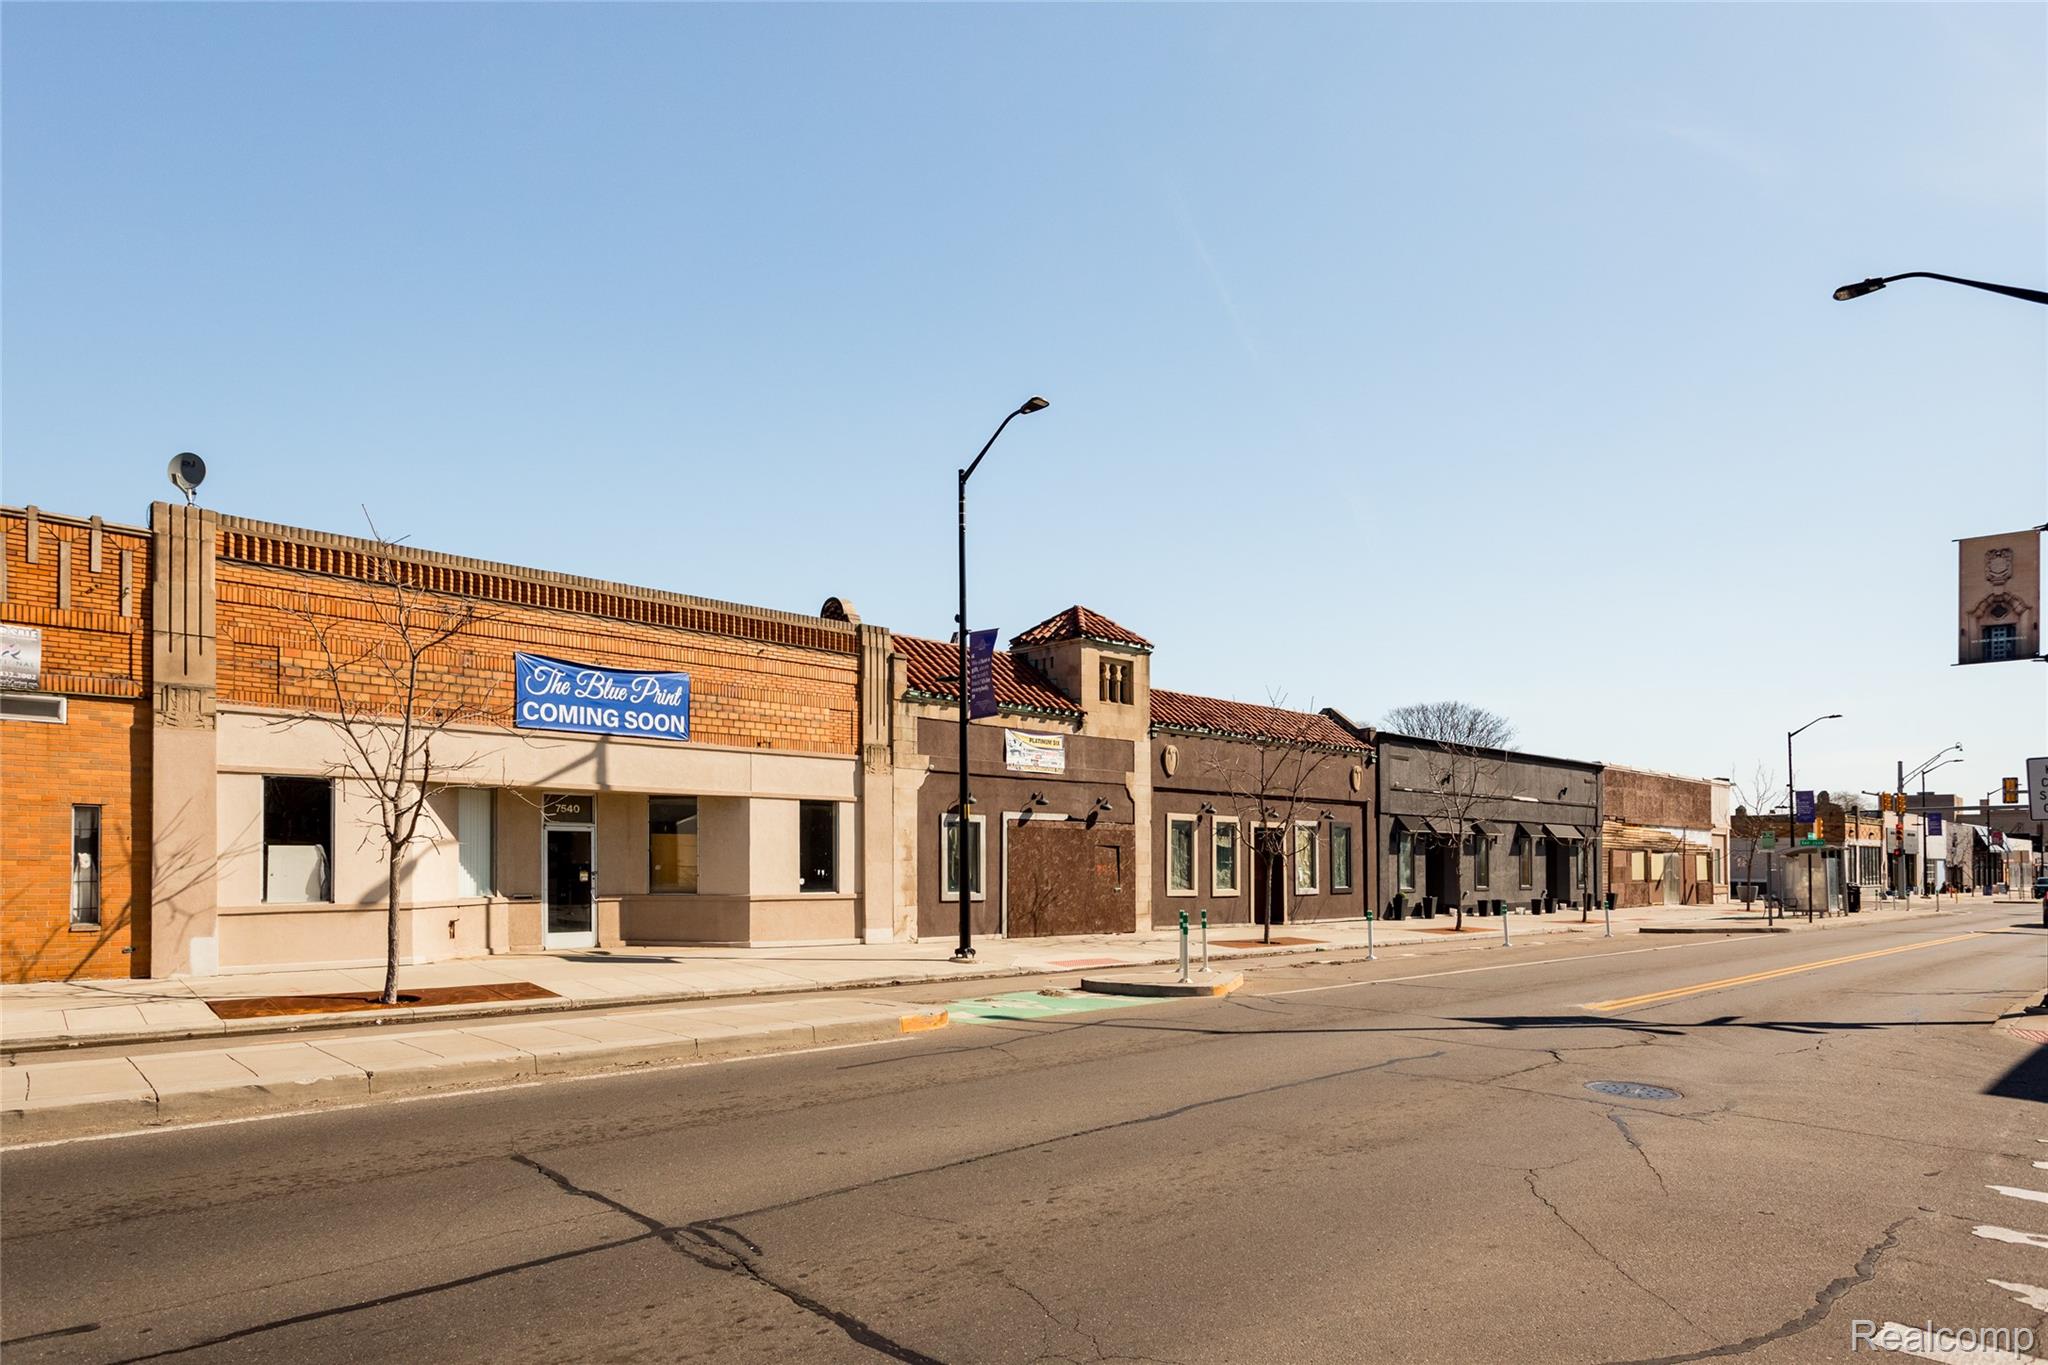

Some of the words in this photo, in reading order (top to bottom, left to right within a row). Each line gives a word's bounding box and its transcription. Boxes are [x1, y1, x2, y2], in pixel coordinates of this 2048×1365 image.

[525, 665, 571, 696] The
[575, 670, 628, 701] Blue
[630, 676, 683, 707] Print
[522, 701, 619, 729] COMING
[624, 711, 686, 734] SOON
[555, 804, 580, 814] 7540
